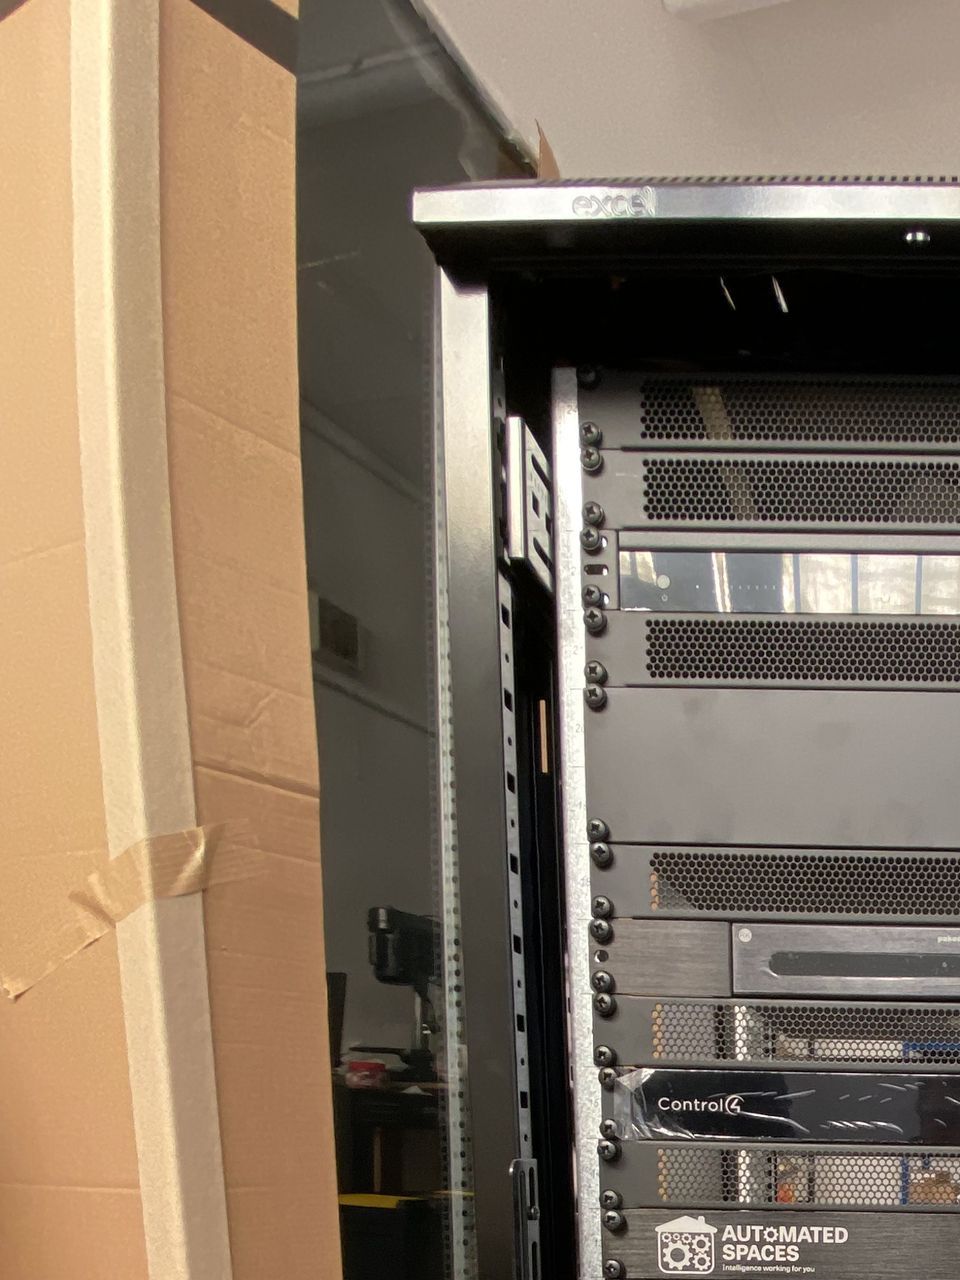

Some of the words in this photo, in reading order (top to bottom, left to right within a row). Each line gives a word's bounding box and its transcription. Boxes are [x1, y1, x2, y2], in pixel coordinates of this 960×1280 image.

[572, 186, 656, 217] excel
[721, 1225, 849, 1244] AUTOMATED
[722, 1244, 800, 1262] SPACES
[762, 1265, 791, 1274] working
